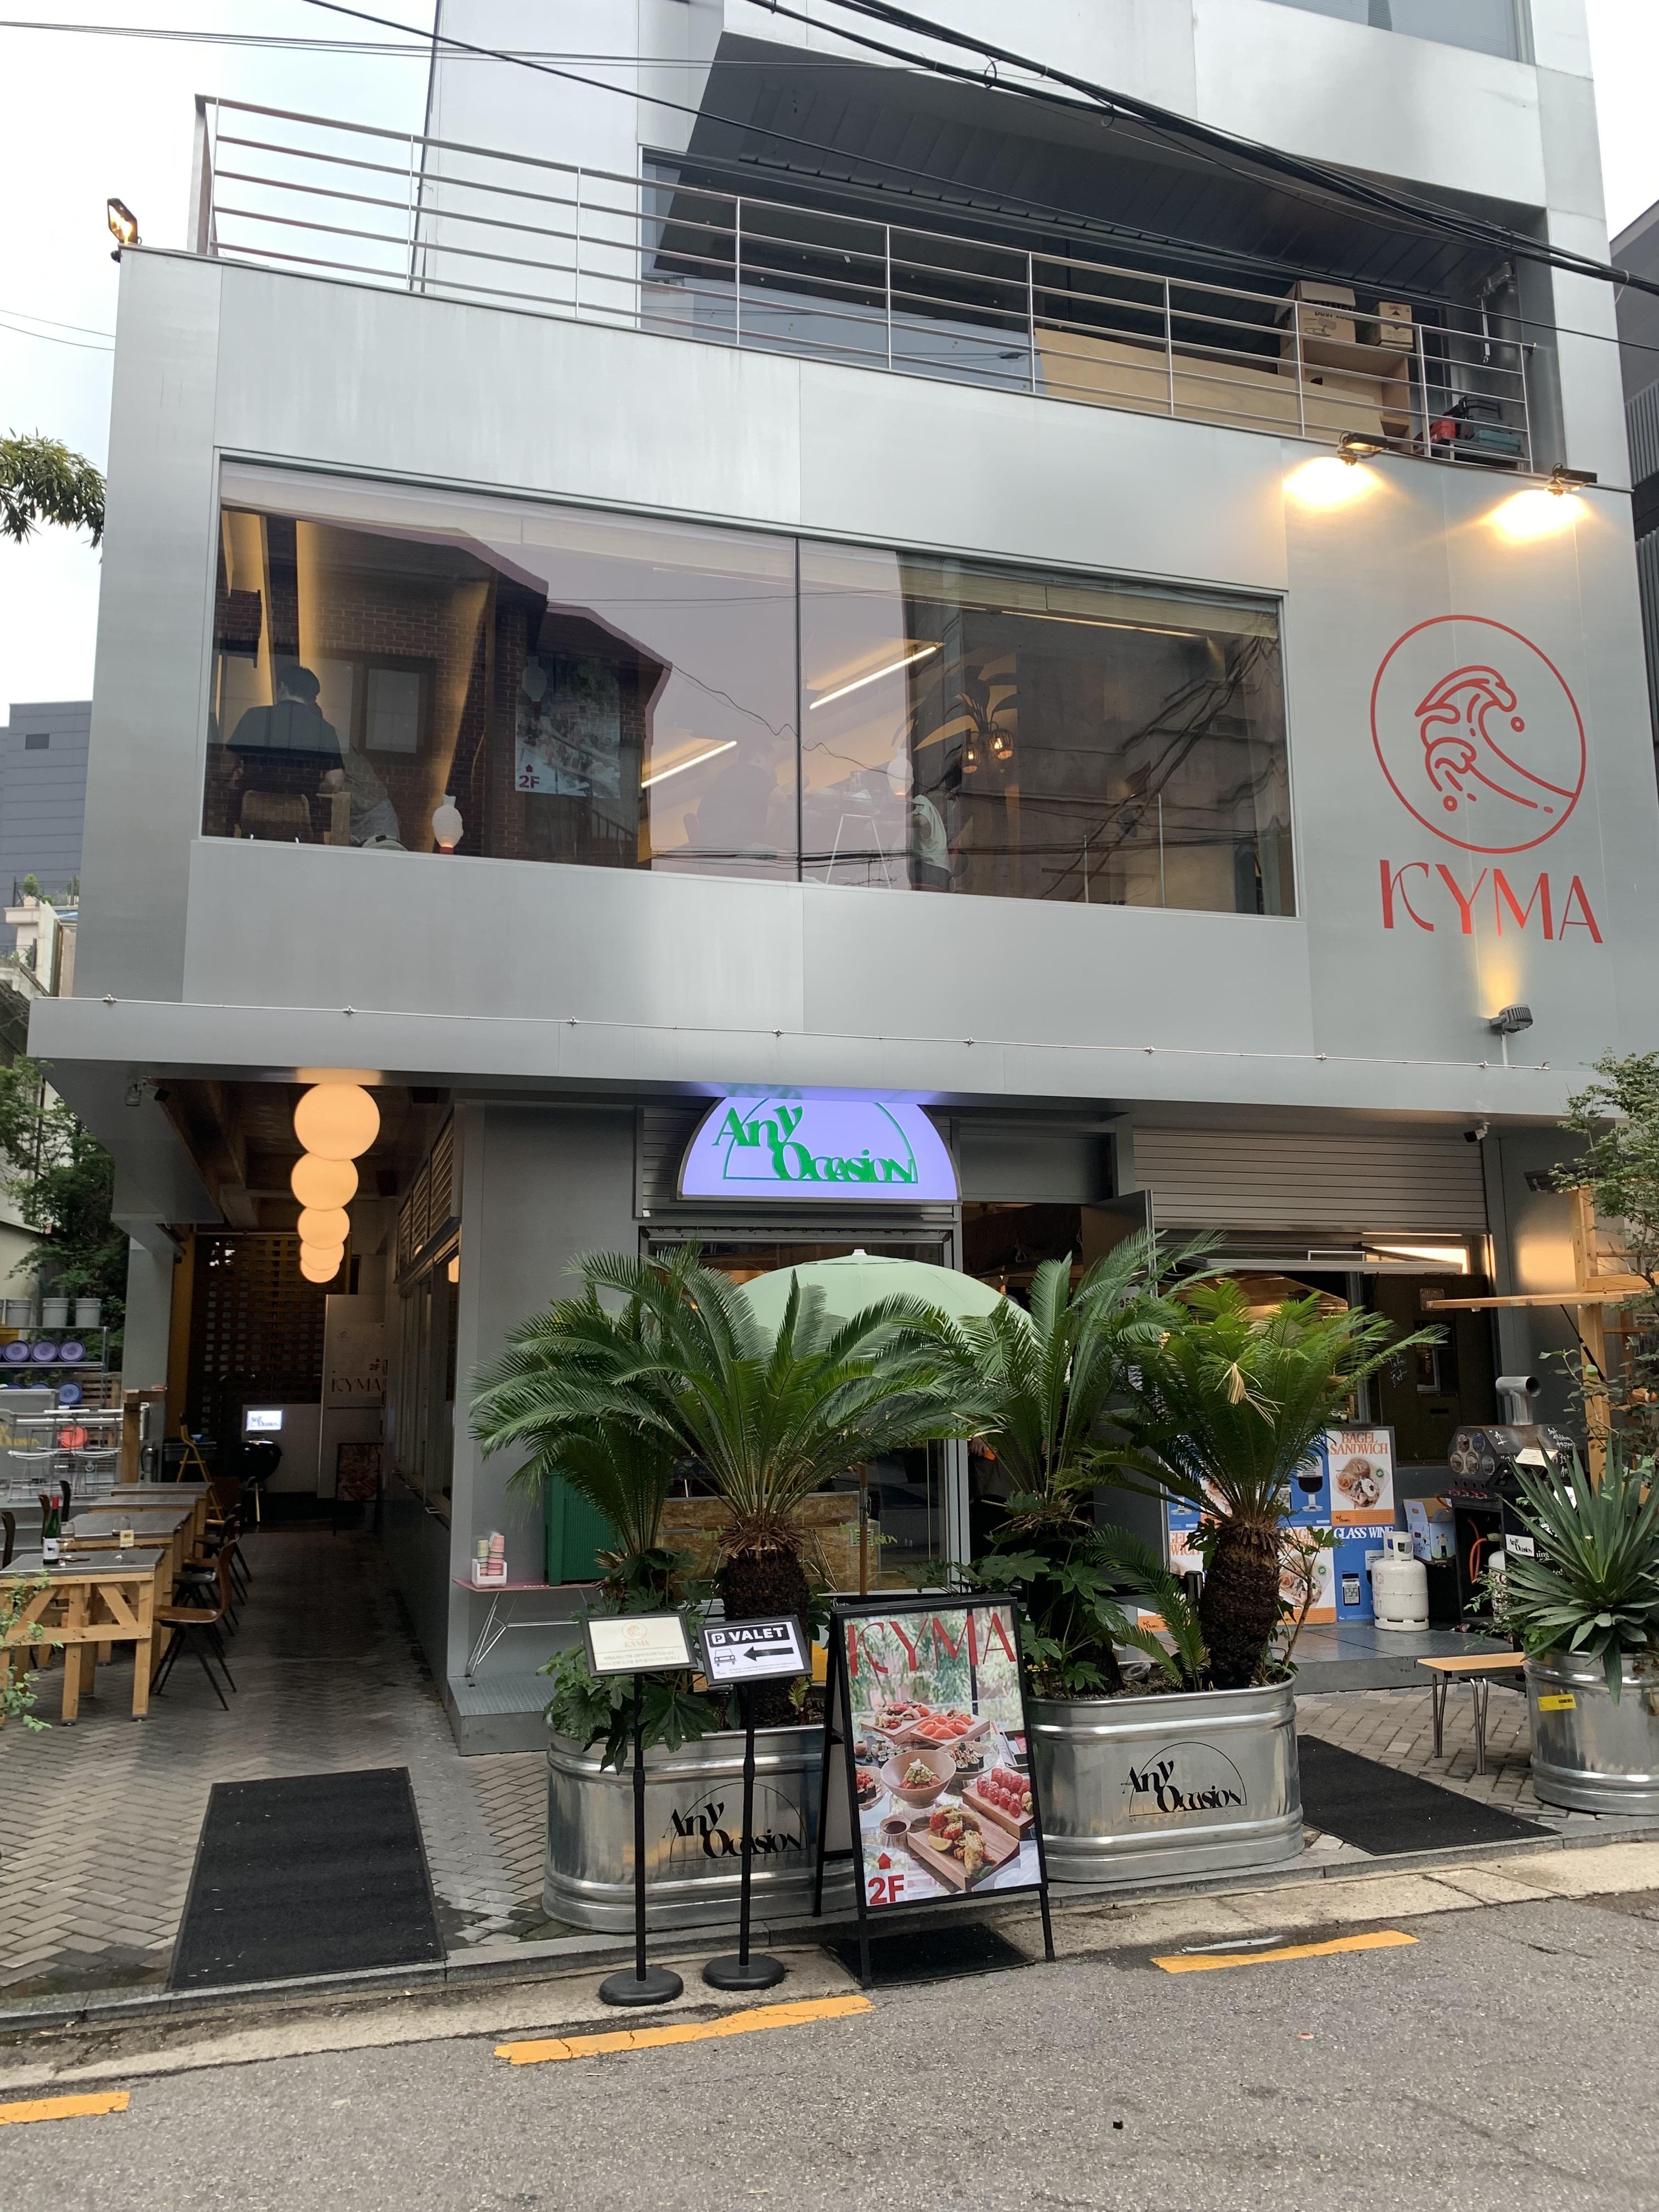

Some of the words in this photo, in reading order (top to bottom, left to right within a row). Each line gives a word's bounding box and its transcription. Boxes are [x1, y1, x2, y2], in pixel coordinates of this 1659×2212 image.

[518, 775, 540, 789] 2F
[1379, 859, 1603, 944] KYMA
[331, 1378, 381, 1392] KYMA
[1342, 1432, 1378, 1443] BAGEL
[1330, 1443, 1389, 1455] SANDWICH
[1333, 1527, 1367, 1539] GLASS
[728, 1627, 784, 1642] VALET
[624, 1640, 650, 1648] KYMA
[847, 1612, 1017, 1677] KYMA
[867, 1874, 906, 1905] 2F
